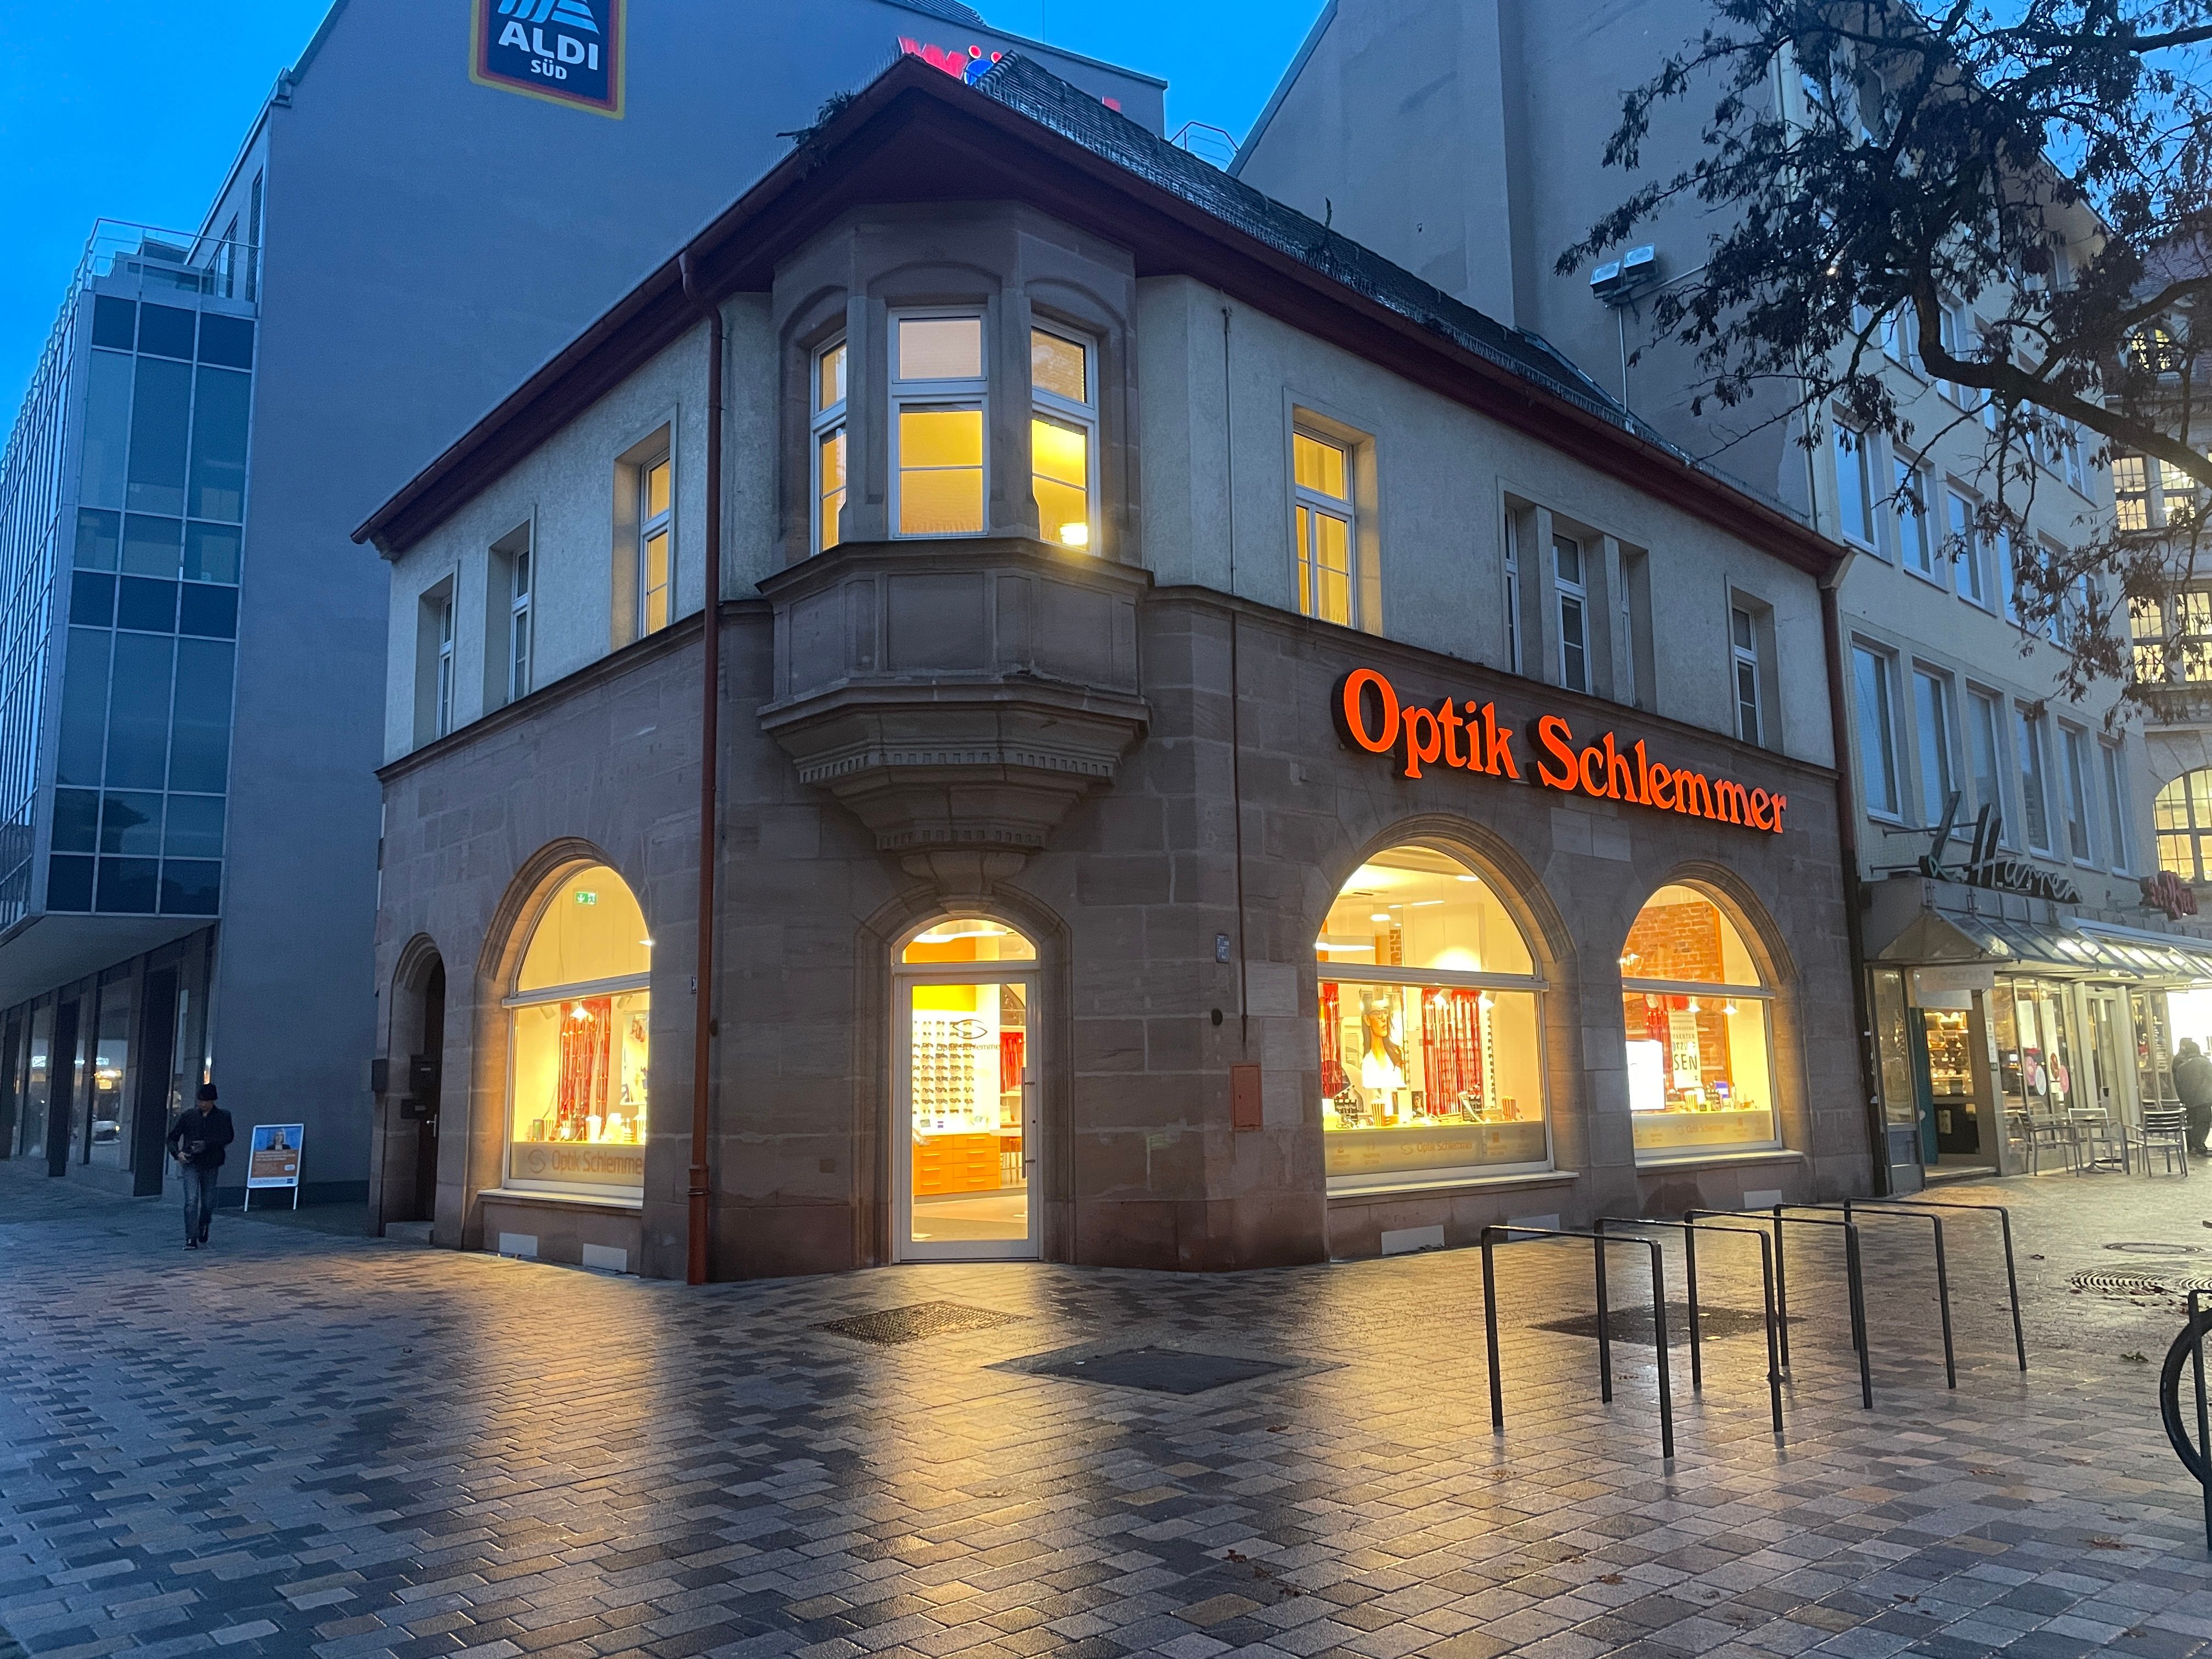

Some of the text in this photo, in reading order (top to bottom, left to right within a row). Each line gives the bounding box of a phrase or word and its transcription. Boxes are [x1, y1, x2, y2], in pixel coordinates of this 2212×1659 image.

[498, 21, 599, 70] ALDI
[531, 59, 567, 80] SÜD
[1343, 668, 1788, 833] Optik Schlemmer
[552, 1149, 643, 1175] Optik Schlemme
